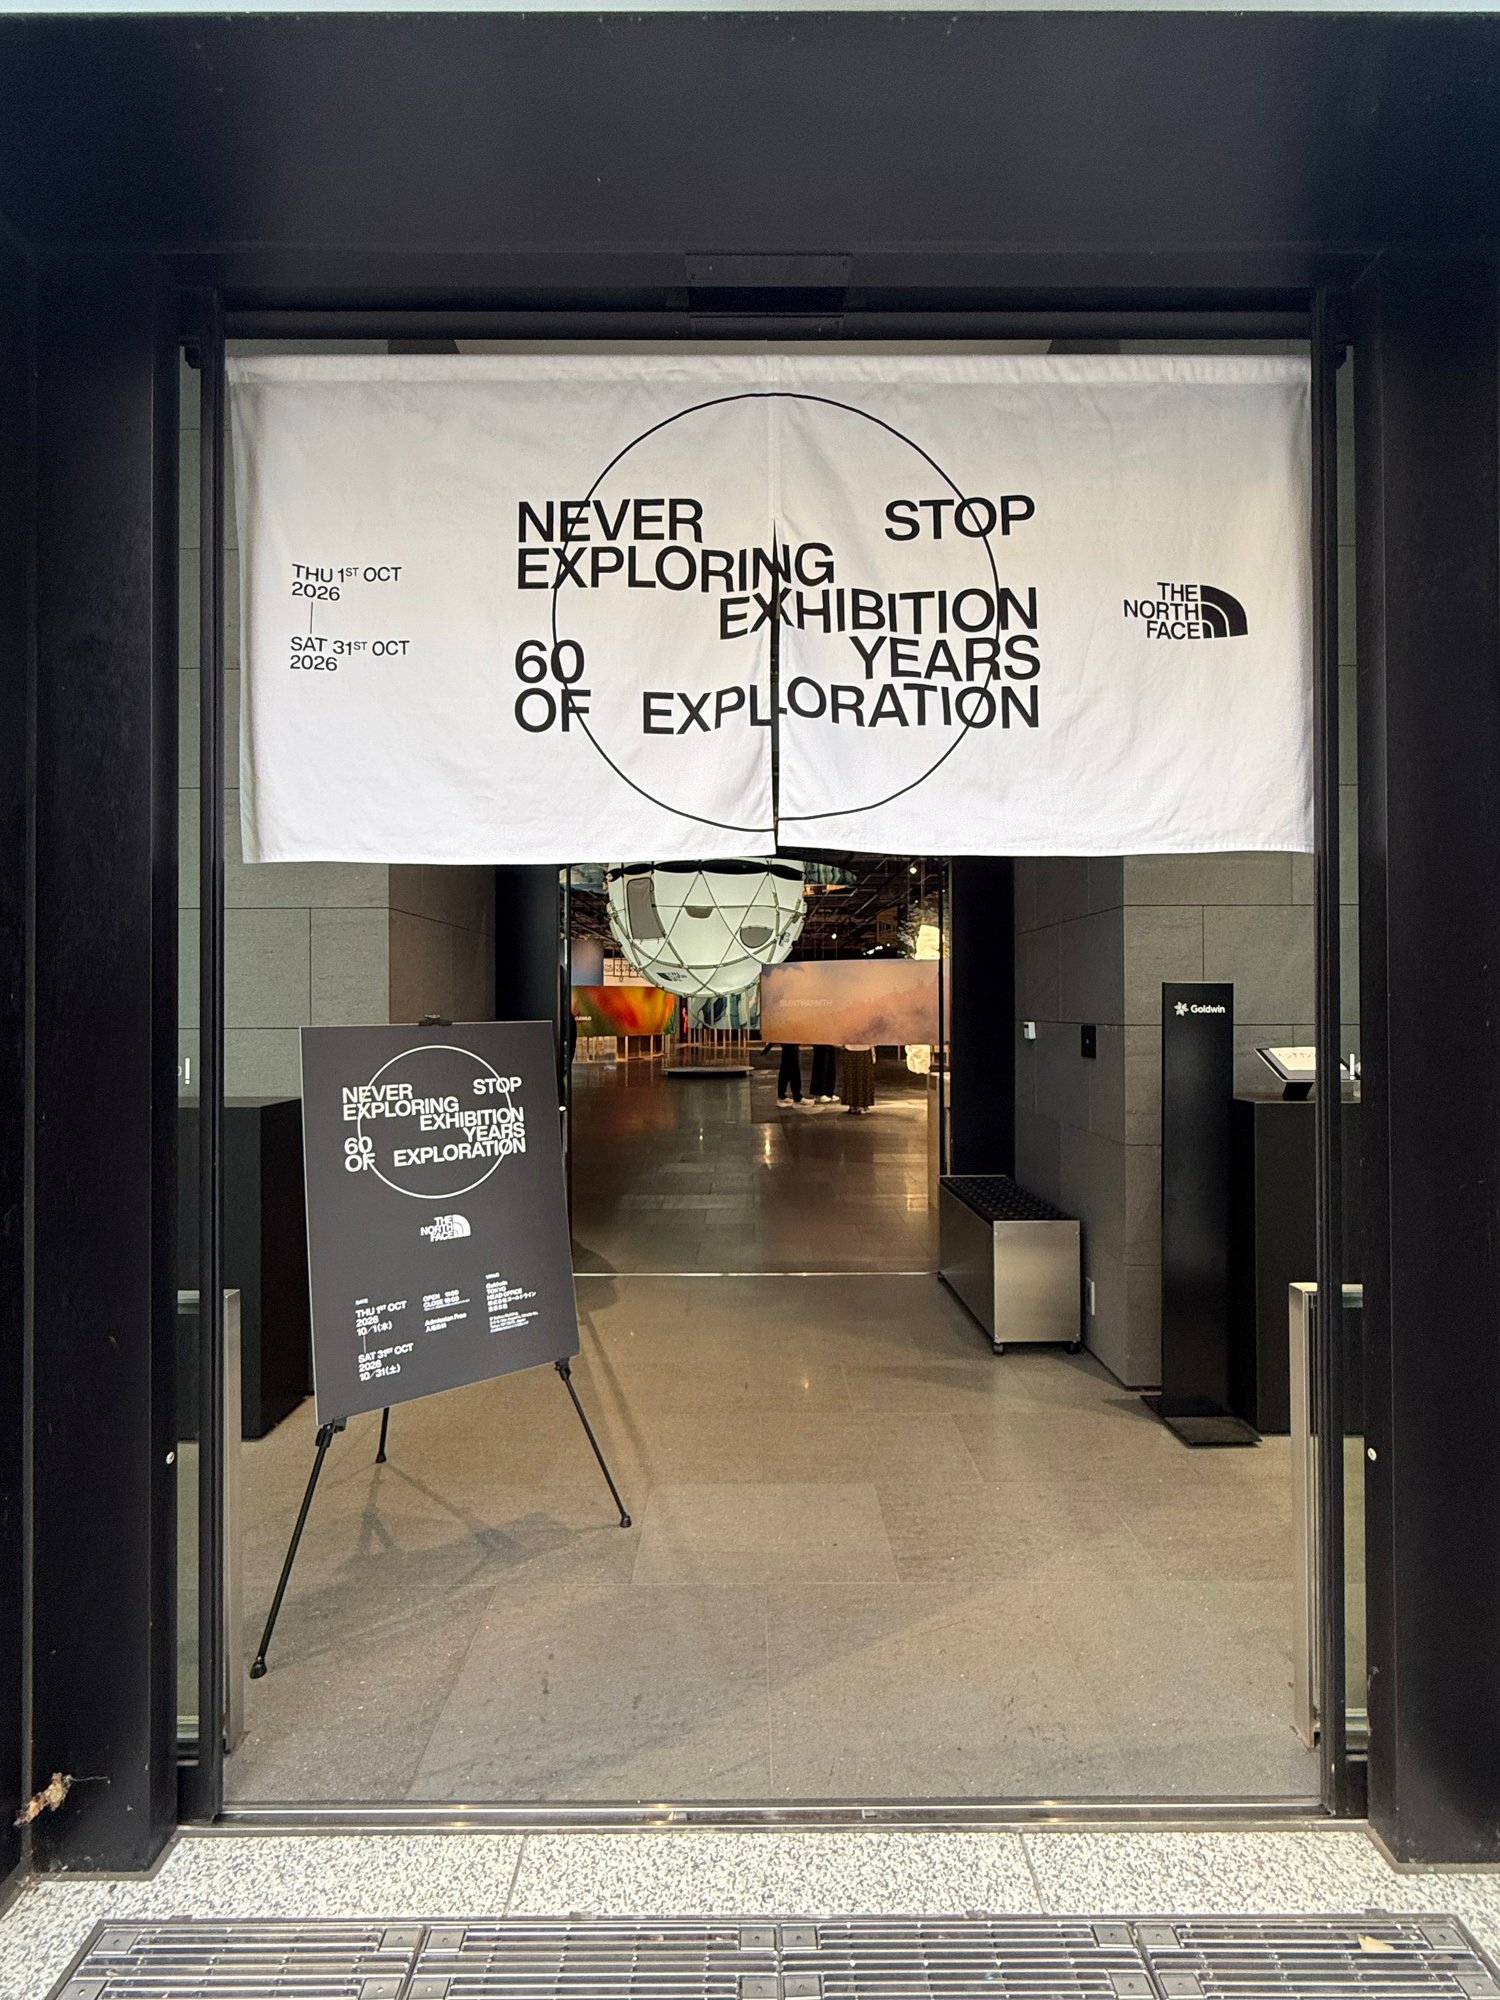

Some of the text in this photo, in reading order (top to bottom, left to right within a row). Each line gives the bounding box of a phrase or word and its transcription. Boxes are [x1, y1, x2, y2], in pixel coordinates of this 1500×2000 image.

[518, 495, 1035, 543] NEVER STOP
[291, 563, 333, 583] THU
[363, 566, 402, 583] OCT
[517, 542, 835, 593] EXPLORING
[291, 581, 340, 602] 2026
[1157, 582, 1198, 602] THE
[719, 587, 1038, 640] EXHIBITION
[1124, 599, 1200, 621] NORTH
[1146, 620, 1201, 640] FACE
[290, 637, 327, 654] SAT
[372, 640, 410, 656] OCT
[290, 655, 338, 671] 2026
[515, 635, 1041, 684] 60 YEARS
[514, 676, 1040, 735] OF EXPLORATION
[1190, 1003, 1226, 1014] Goldwin
[342, 1077, 522, 1104] NEVER STOP
[343, 1097, 459, 1121] EXPLORING
[420, 1107, 524, 1131] EXHIBITION
[344, 1123, 525, 1155] 60 YEARS
[344, 1138, 527, 1173] OF EXPLORATION
[420, 1222, 453, 1236] NORTH
[434, 1214, 453, 1226] THE
[430, 1231, 454, 1242] FACE
[423, 1293, 440, 1302] OPEN
[486, 1286, 506, 1295] TOKYO
[487, 1288, 523, 1301] HEAD OFFICE
[355, 1307, 375, 1318] THU
[387, 1300, 407, 1312] OCT
[423, 1299, 443, 1308] CLOSE
[356, 1315, 379, 1328] 2026
[454, 1312, 467, 1320] Free
[358, 1351, 376, 1364] SAT
[394, 1342, 414, 1355] OCT
[358, 1359, 382, 1373] 2026
